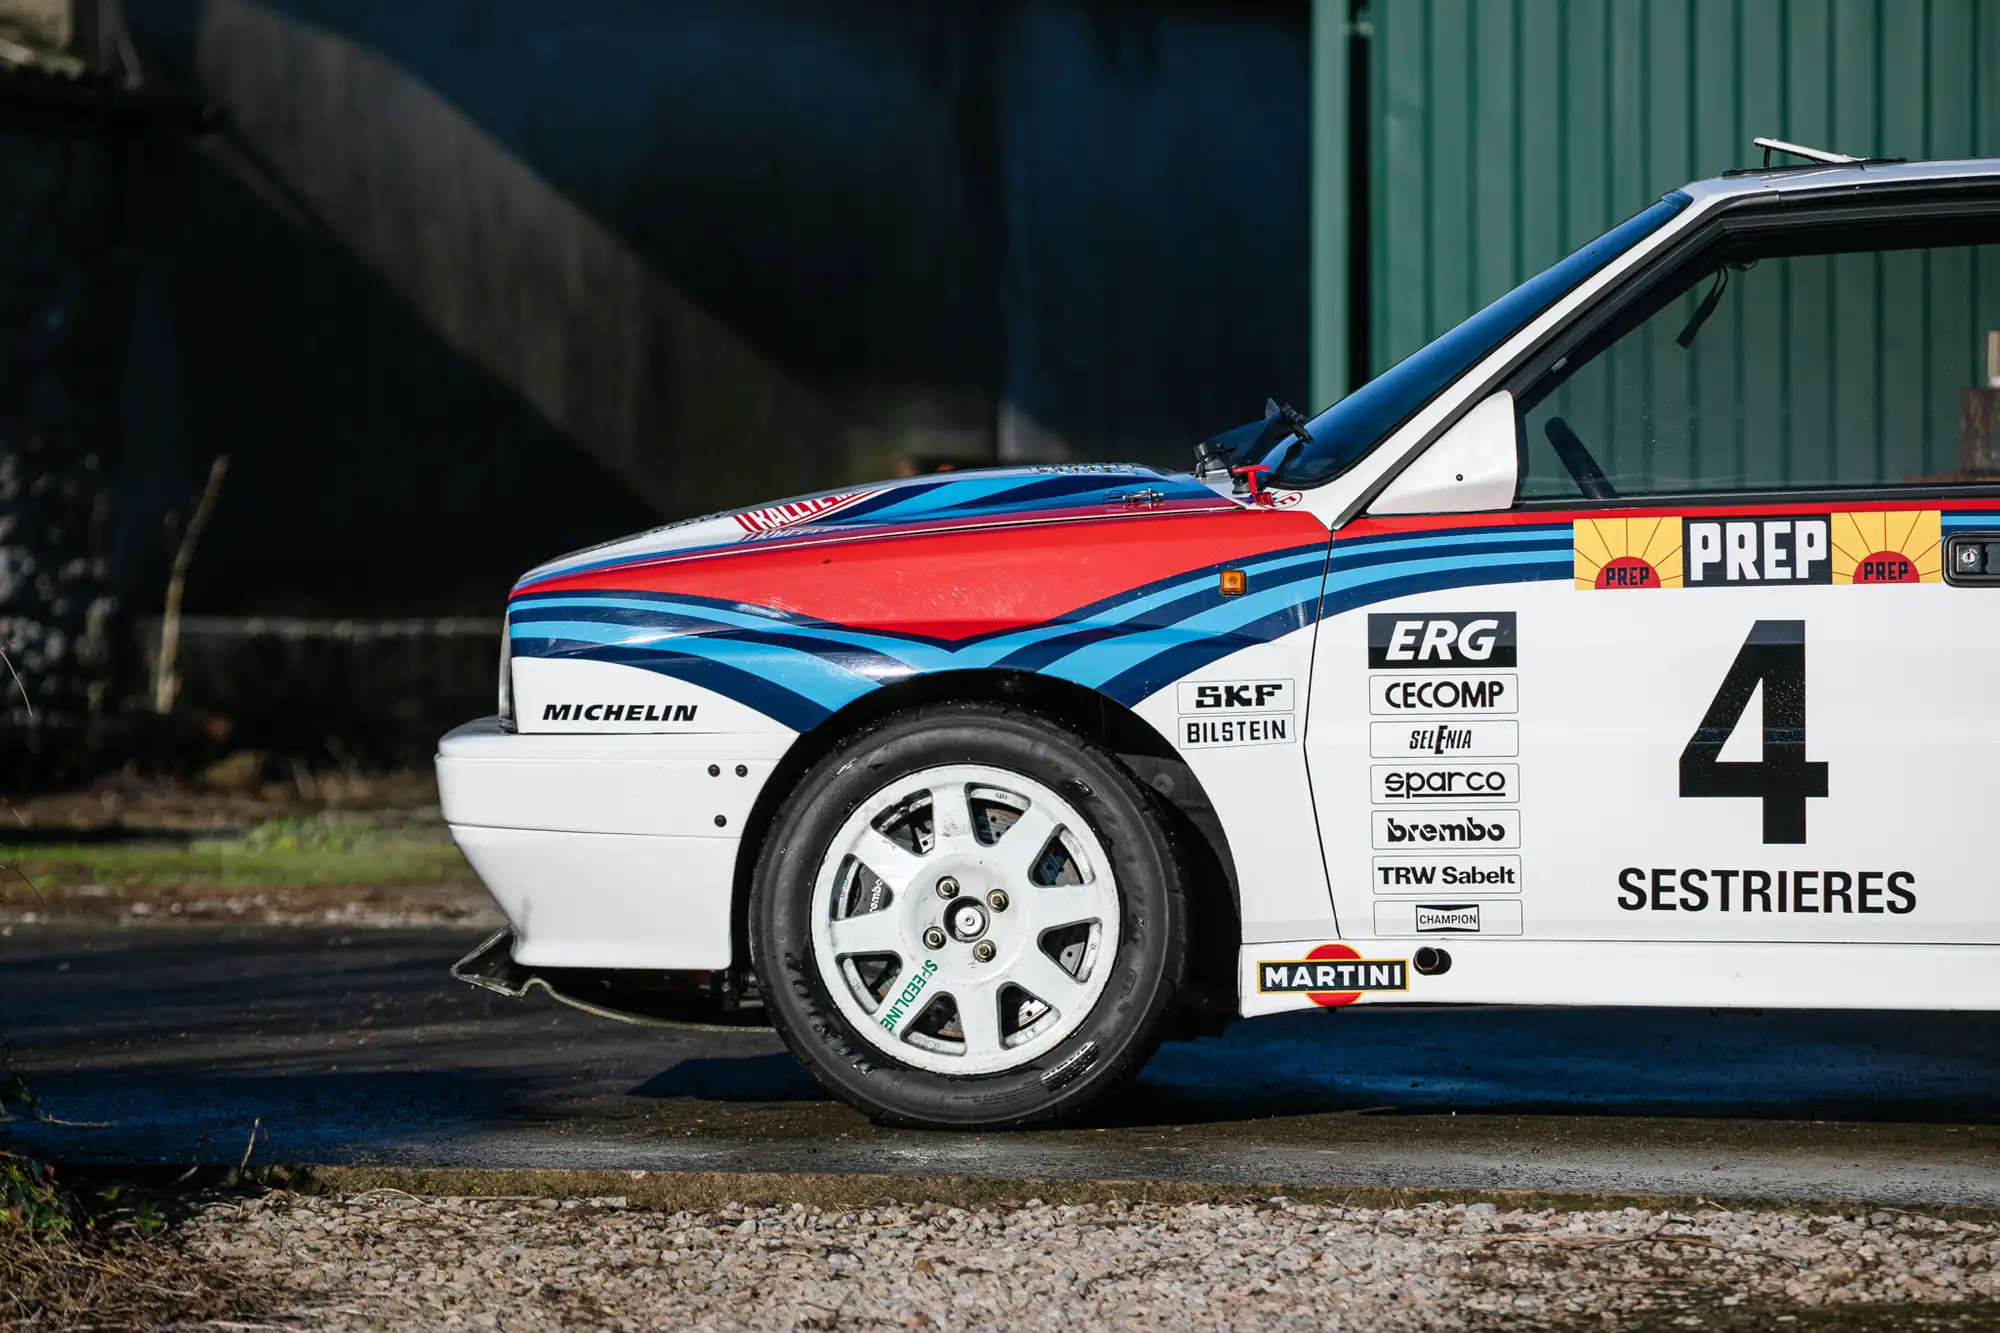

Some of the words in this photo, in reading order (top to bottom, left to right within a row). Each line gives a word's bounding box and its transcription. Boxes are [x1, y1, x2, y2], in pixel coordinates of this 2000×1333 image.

[1690, 520, 1827, 581] PREP
[1606, 567, 1649, 586] PREP
[1864, 561, 1908, 580] PREP
[1385, 619, 1499, 661] ERG
[1196, 684, 1282, 708] SKF
[1385, 681, 1504, 708] CECOMP
[542, 704, 698, 721] MICHELIN
[1187, 719, 1286, 743] BILSTEIN
[1679, 620, 1829, 844] 4
[1384, 771, 1506, 799] sparco
[1387, 817, 1505, 842] brembo
[1378, 867, 1436, 885] TRW
[1442, 866, 1515, 884] Sabelt
[1617, 867, 1917, 914] SESTRIERES
[1419, 914, 1477, 925] CHAMPION
[1265, 964, 1401, 988] MARTINI
[880, 959, 938, 1032] SPEEDLINE
